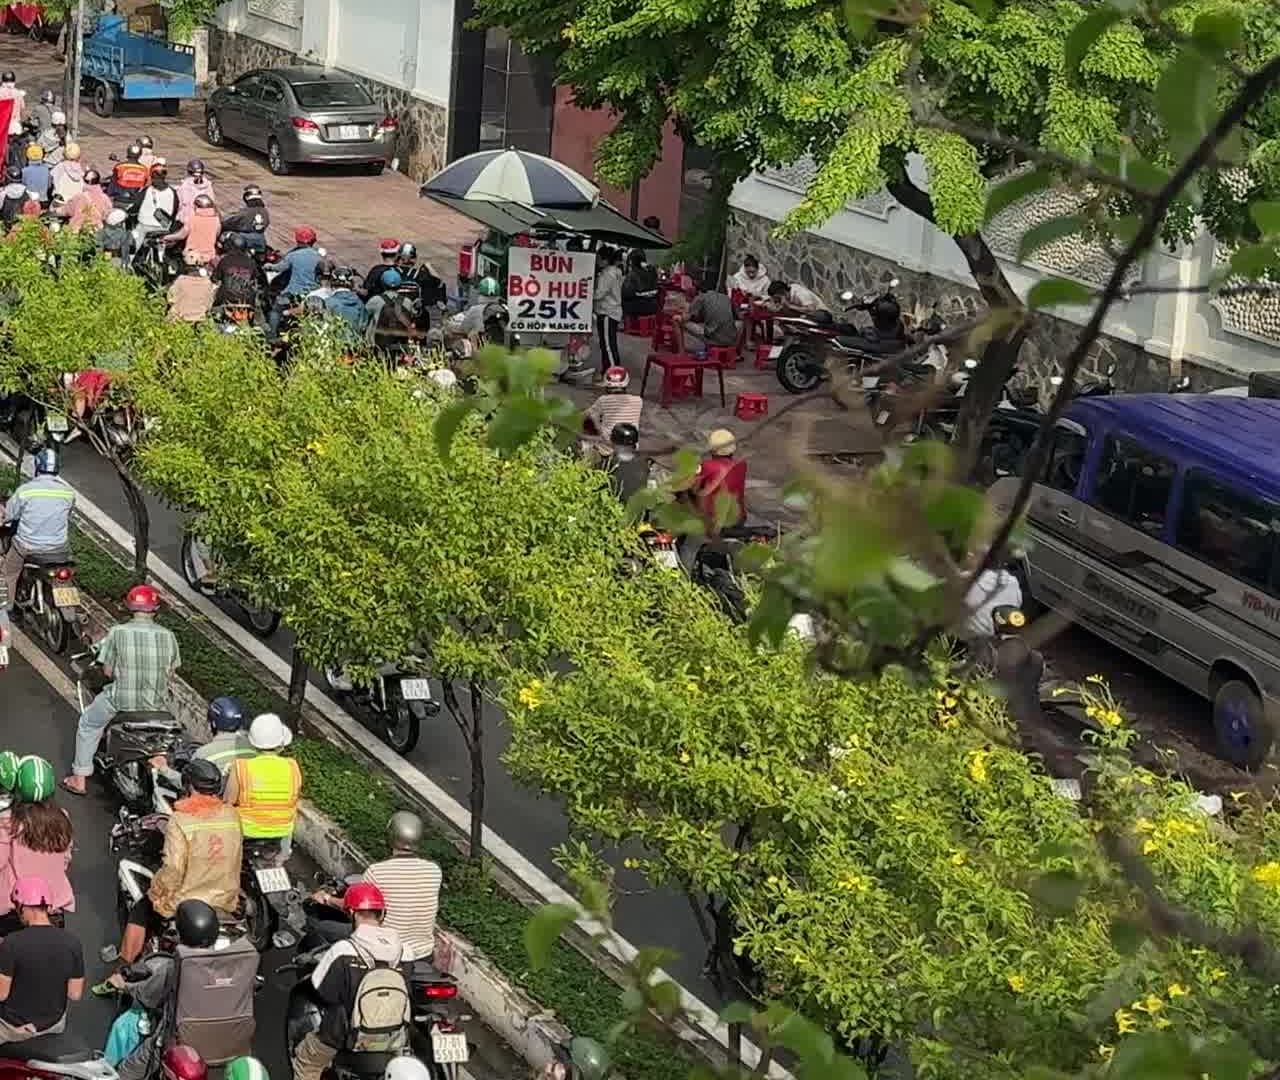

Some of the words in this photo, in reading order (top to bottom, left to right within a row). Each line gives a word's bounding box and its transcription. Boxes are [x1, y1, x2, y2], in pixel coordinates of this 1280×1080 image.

[509, 274, 541, 297] BÒ
[547, 276, 592, 299] HUẾ
[518, 299, 581, 319] 25K
